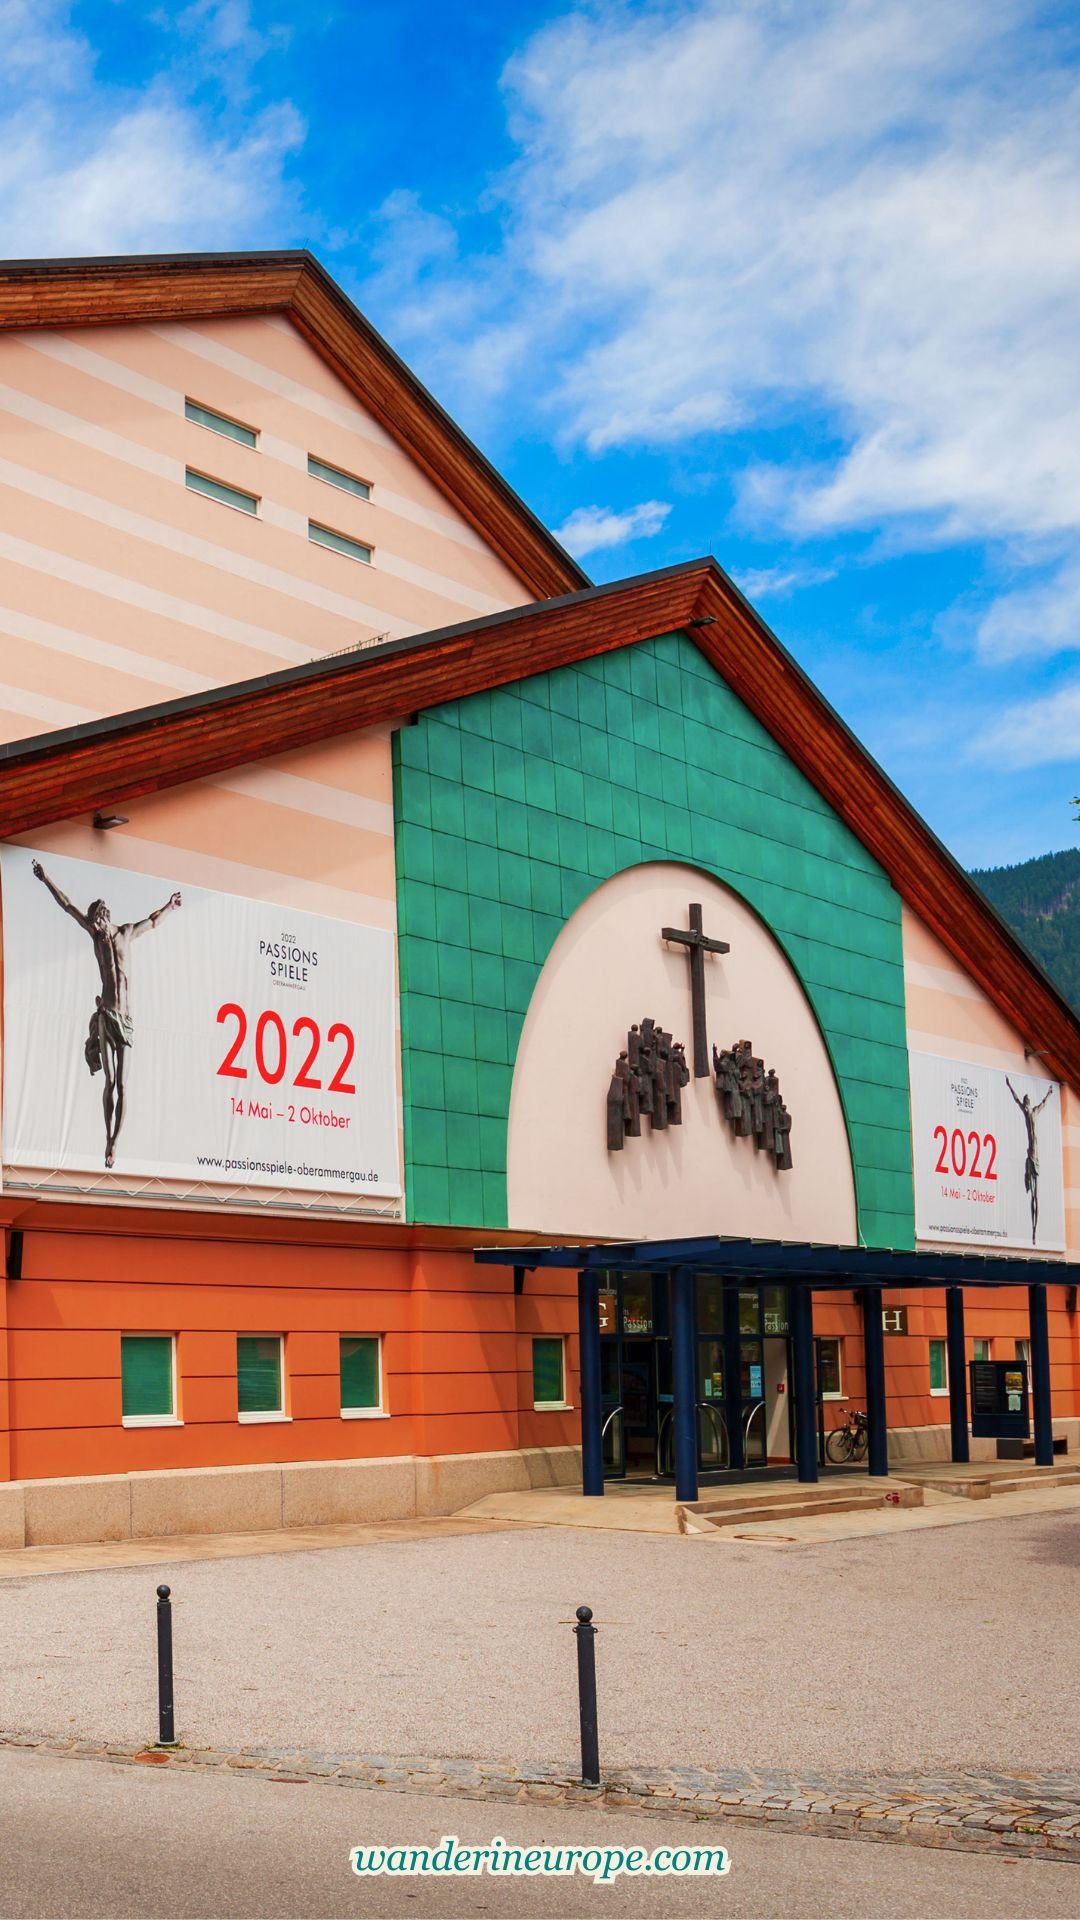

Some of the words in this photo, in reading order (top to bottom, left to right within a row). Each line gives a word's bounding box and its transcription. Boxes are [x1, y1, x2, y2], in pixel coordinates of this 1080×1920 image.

[281, 932, 296, 944] 2022
[259, 940, 318, 966] PASSIONS
[270, 961, 308, 982] SPIELE
[216, 1002, 356, 1095] 2022
[950, 1083, 978, 1098] PASSIONS
[230, 1097, 244, 1117] 14
[248, 1101, 273, 1120] Mai
[288, 1105, 296, 1123] 2
[300, 1106, 351, 1129] Oktober
[956, 1096, 975, 1109] SPIELE
[933, 1125, 998, 1181] 2022
[196, 1155, 379, 1184] www.passionsspiele-oberammergau.de
[941, 1185, 948, 1198] 14
[949, 1187, 961, 1200] Mai
[967, 1188, 971, 1201] 2
[972, 1189, 996, 1204] Oktober
[623, 1315, 653, 1330] Passion
[882, 1310, 903, 1331] H
